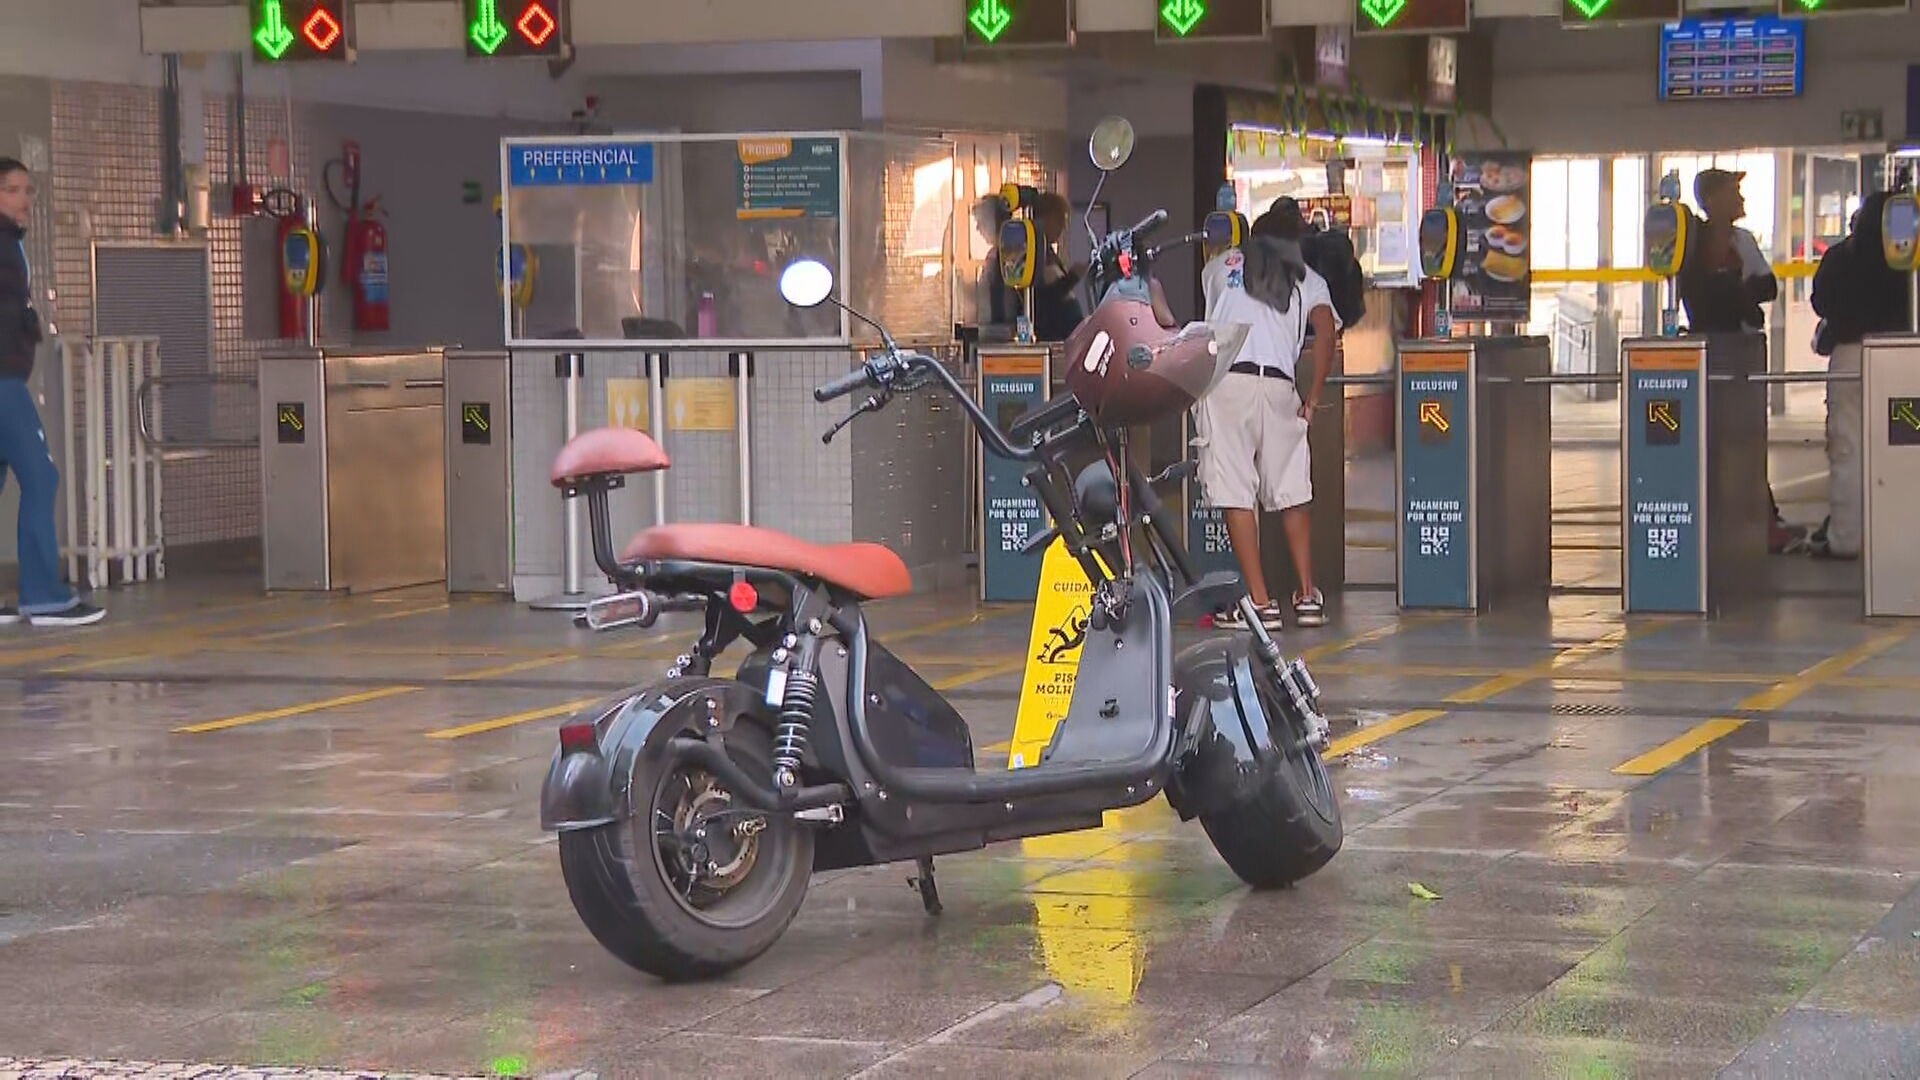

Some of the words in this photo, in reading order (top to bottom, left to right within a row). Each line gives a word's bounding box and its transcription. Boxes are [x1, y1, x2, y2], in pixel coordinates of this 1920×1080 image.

[523, 148, 639, 167] PREFERENCIAL
[991, 383, 1034, 394] EXCLUSIVO
[1411, 380, 1458, 391] EXCLUSIVO
[1638, 378, 1689, 389] EXCLUSIVO
[992, 498, 1037, 508] PAGAMENTO
[1410, 500, 1459, 511] PAGAMENTO
[1637, 502, 1689, 513] PAGAMENTO
[989, 509, 1005, 519] POR
[1007, 509, 1018, 520] QR
[1020, 509, 1040, 519] CODE
[1407, 512, 1424, 522] POR
[1427, 512, 1438, 522] QR
[1441, 512, 1462, 522] CODE
[1633, 513, 1652, 524] POR
[1654, 513, 1667, 525] QR
[1669, 513, 1692, 525] CODE
[1055, 673, 1077, 683] PIS
[1035, 684, 1072, 695] MOLH
